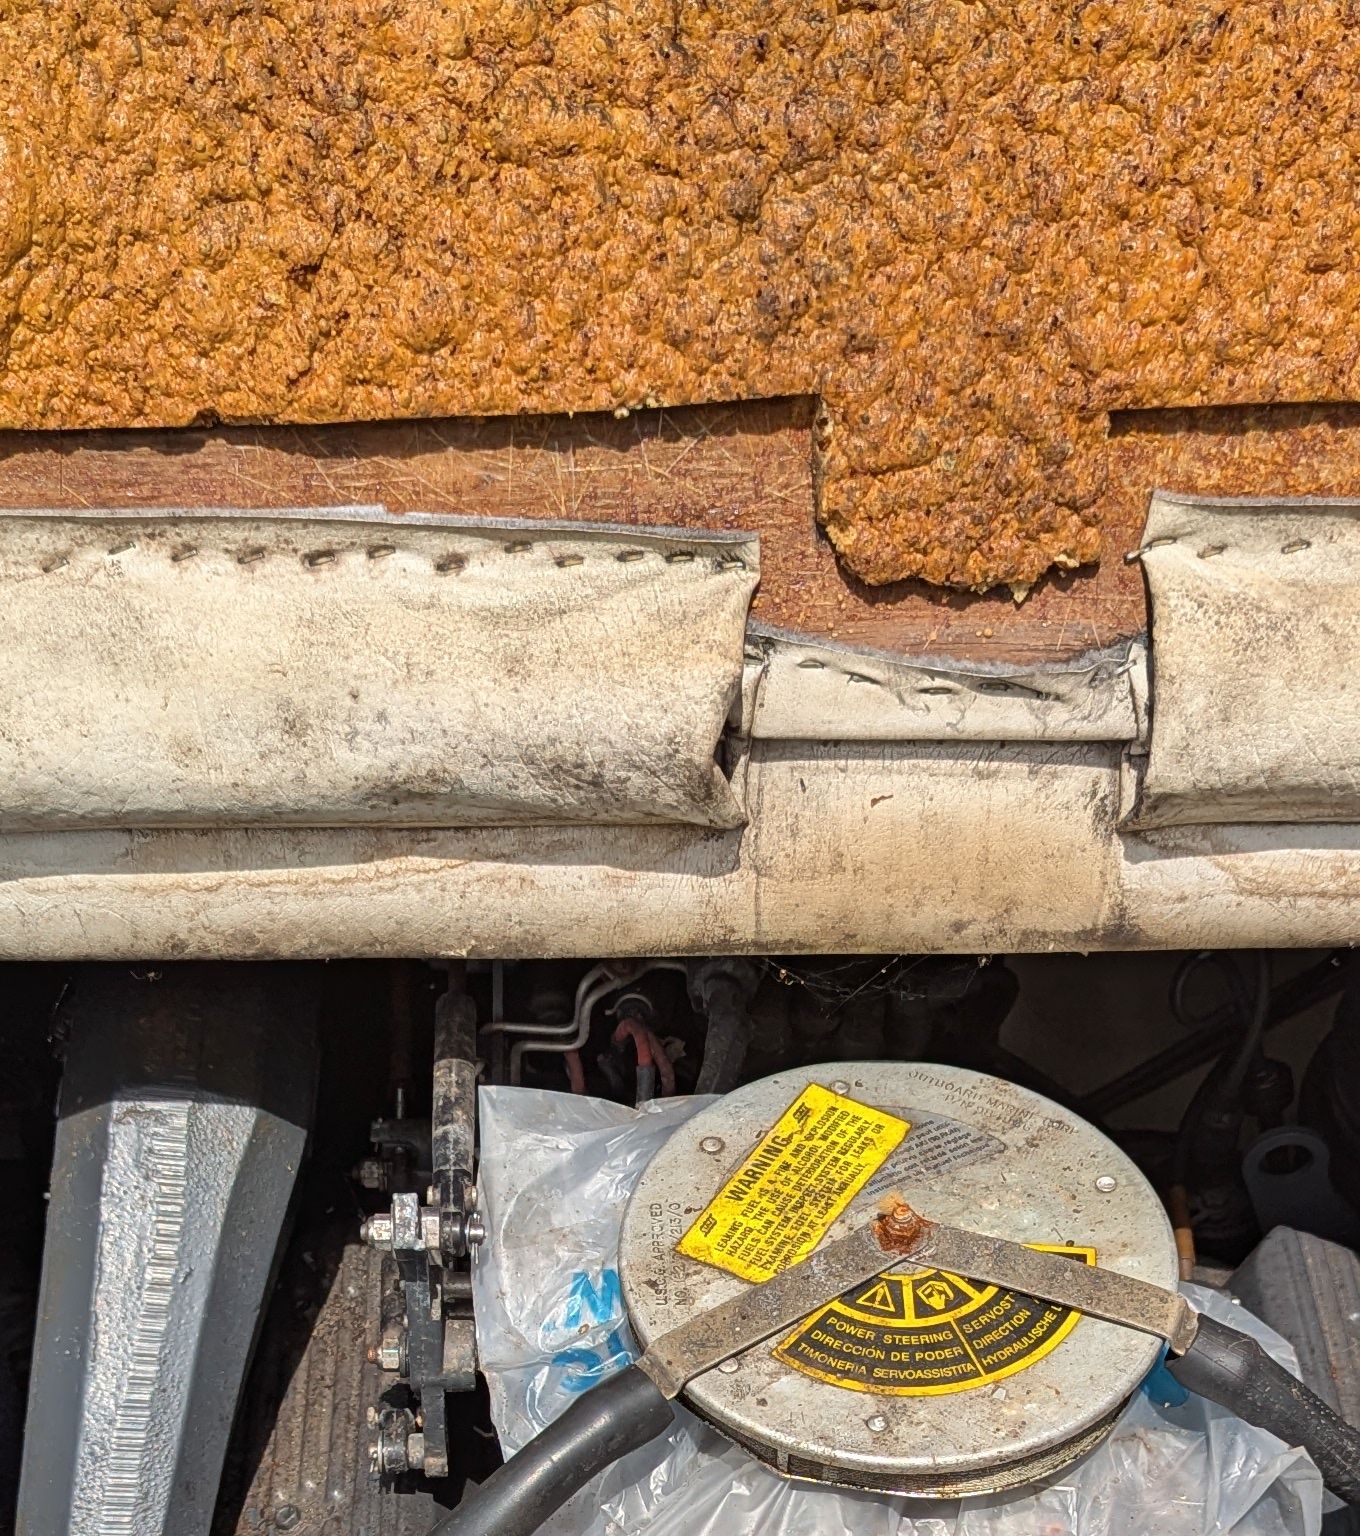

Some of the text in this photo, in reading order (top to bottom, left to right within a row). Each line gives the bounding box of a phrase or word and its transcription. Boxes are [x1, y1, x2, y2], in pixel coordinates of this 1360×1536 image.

[712, 1220, 744, 1252] LEAKING
[739, 1197, 761, 1217] FUEL
[756, 1186, 770, 1196] IS
[773, 1160, 792, 1177] FIRE
[788, 1142, 807, 1158] AND
[803, 1104, 839, 1142] EXPLOSION
[723, 1133, 791, 1203] WARNING
[736, 1236, 761, 1261] FUELS
[755, 1218, 775, 1235] CAN
[770, 1192, 796, 1217] CAUSE
[791, 1139, 839, 1192] DETERIORATION
[835, 1128, 849, 1139] OF
[844, 1114, 862, 1128] THE
[751, 1205, 769, 1222] THE
[765, 1187, 784, 1204] USE
[779, 1175, 794, 1187] OF
[789, 1142, 821, 1175] ALCOHOL
[817, 1109, 850, 1142] MODIFIED
[747, 1246, 769, 1266] FUEL
[813, 1155, 841, 1183] SYSTEM
[758, 1233, 795, 1271] EXAMINE
[807, 1176, 839, 1208] SYSTEM
[835, 1160, 852, 1175] FOR
[850, 1135, 873, 1158] LEAKS
[870, 1123, 885, 1134] OR
[805, 1220, 818, 1229] AT
[813, 1196, 837, 1219] LEAST
[650, 1202, 665, 1261] APPROVED
[811, 1330, 964, 1361] DIRECCIÓN DE PODER
[826, 1317, 954, 1345] POWER STEERING
[972, 1308, 1031, 1349] DIRECTION
[981, 1310, 1058, 1366] HYDRAULISCHE
[798, 1342, 976, 1379] TIMONERIA SERVOASSISTITA
